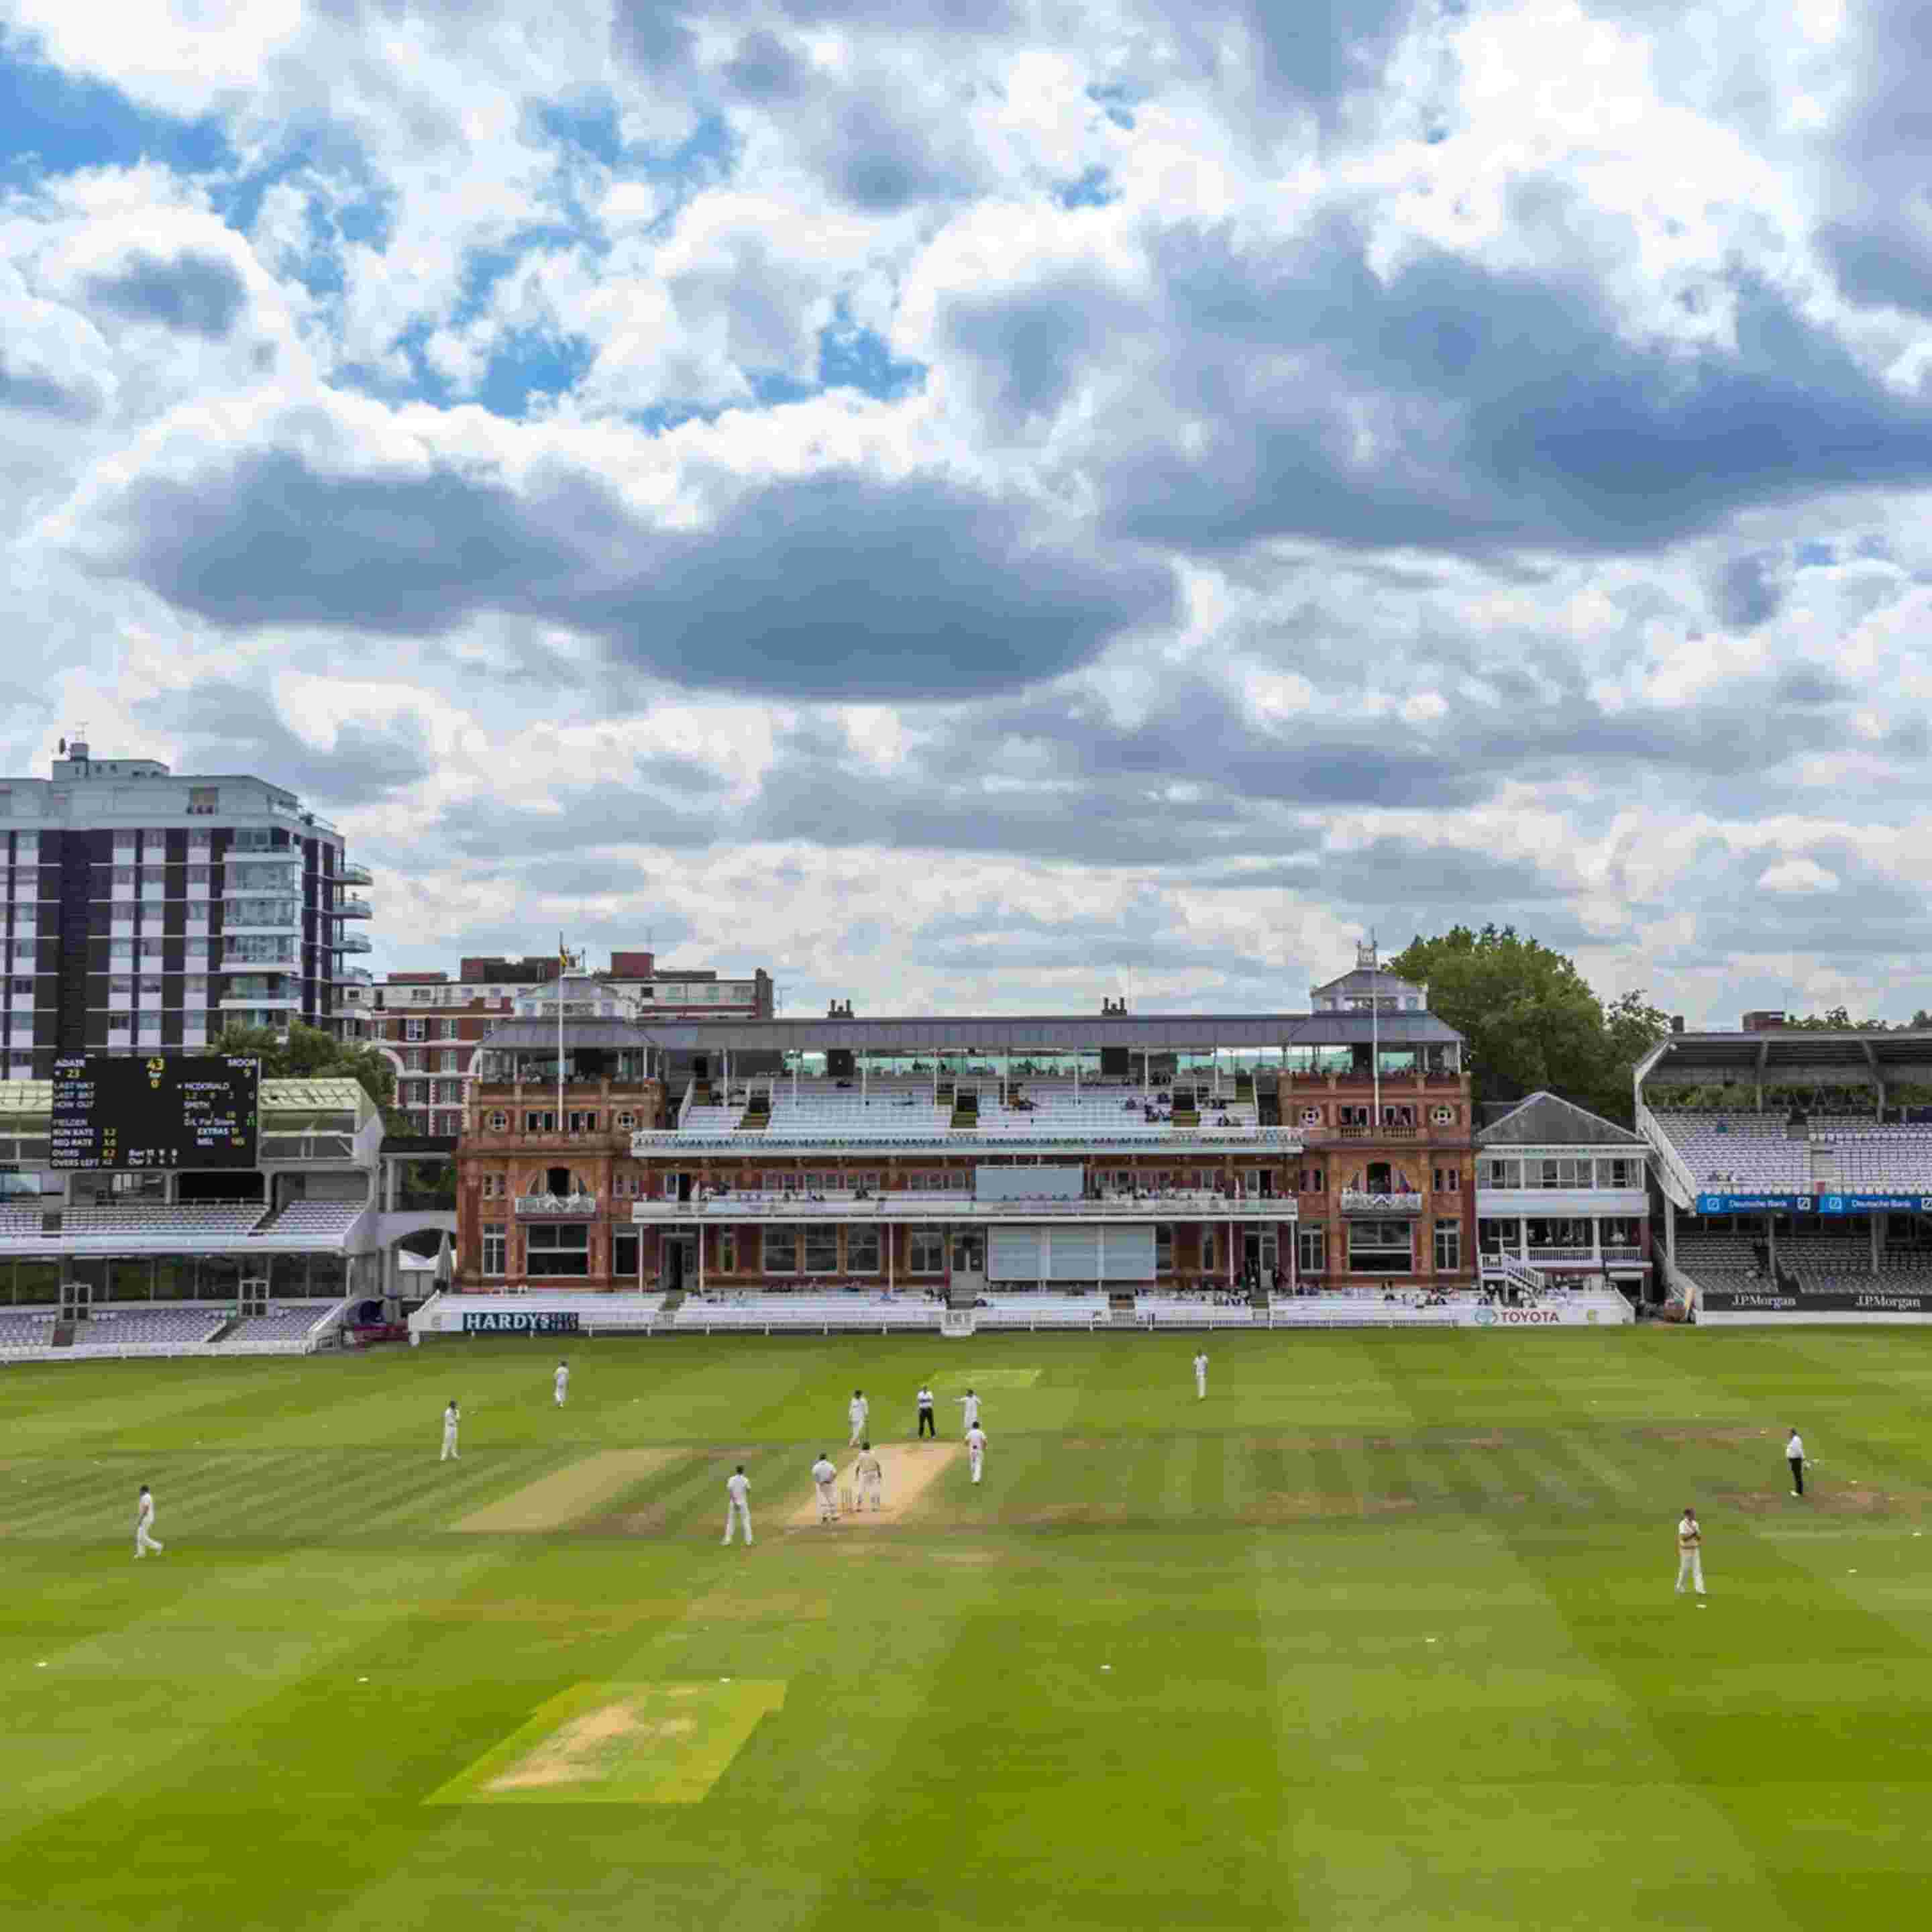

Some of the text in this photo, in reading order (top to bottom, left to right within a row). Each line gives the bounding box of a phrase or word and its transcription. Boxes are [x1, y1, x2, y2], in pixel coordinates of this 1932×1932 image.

[197, 1127, 229, 1135] EXTRAS
[52, 1149, 79, 1157] OVERS
[52, 1159, 78, 1167] OVERS
[1502, 1311, 1560, 1323] TOYOTA
[466, 1313, 549, 1330] HARDYS
